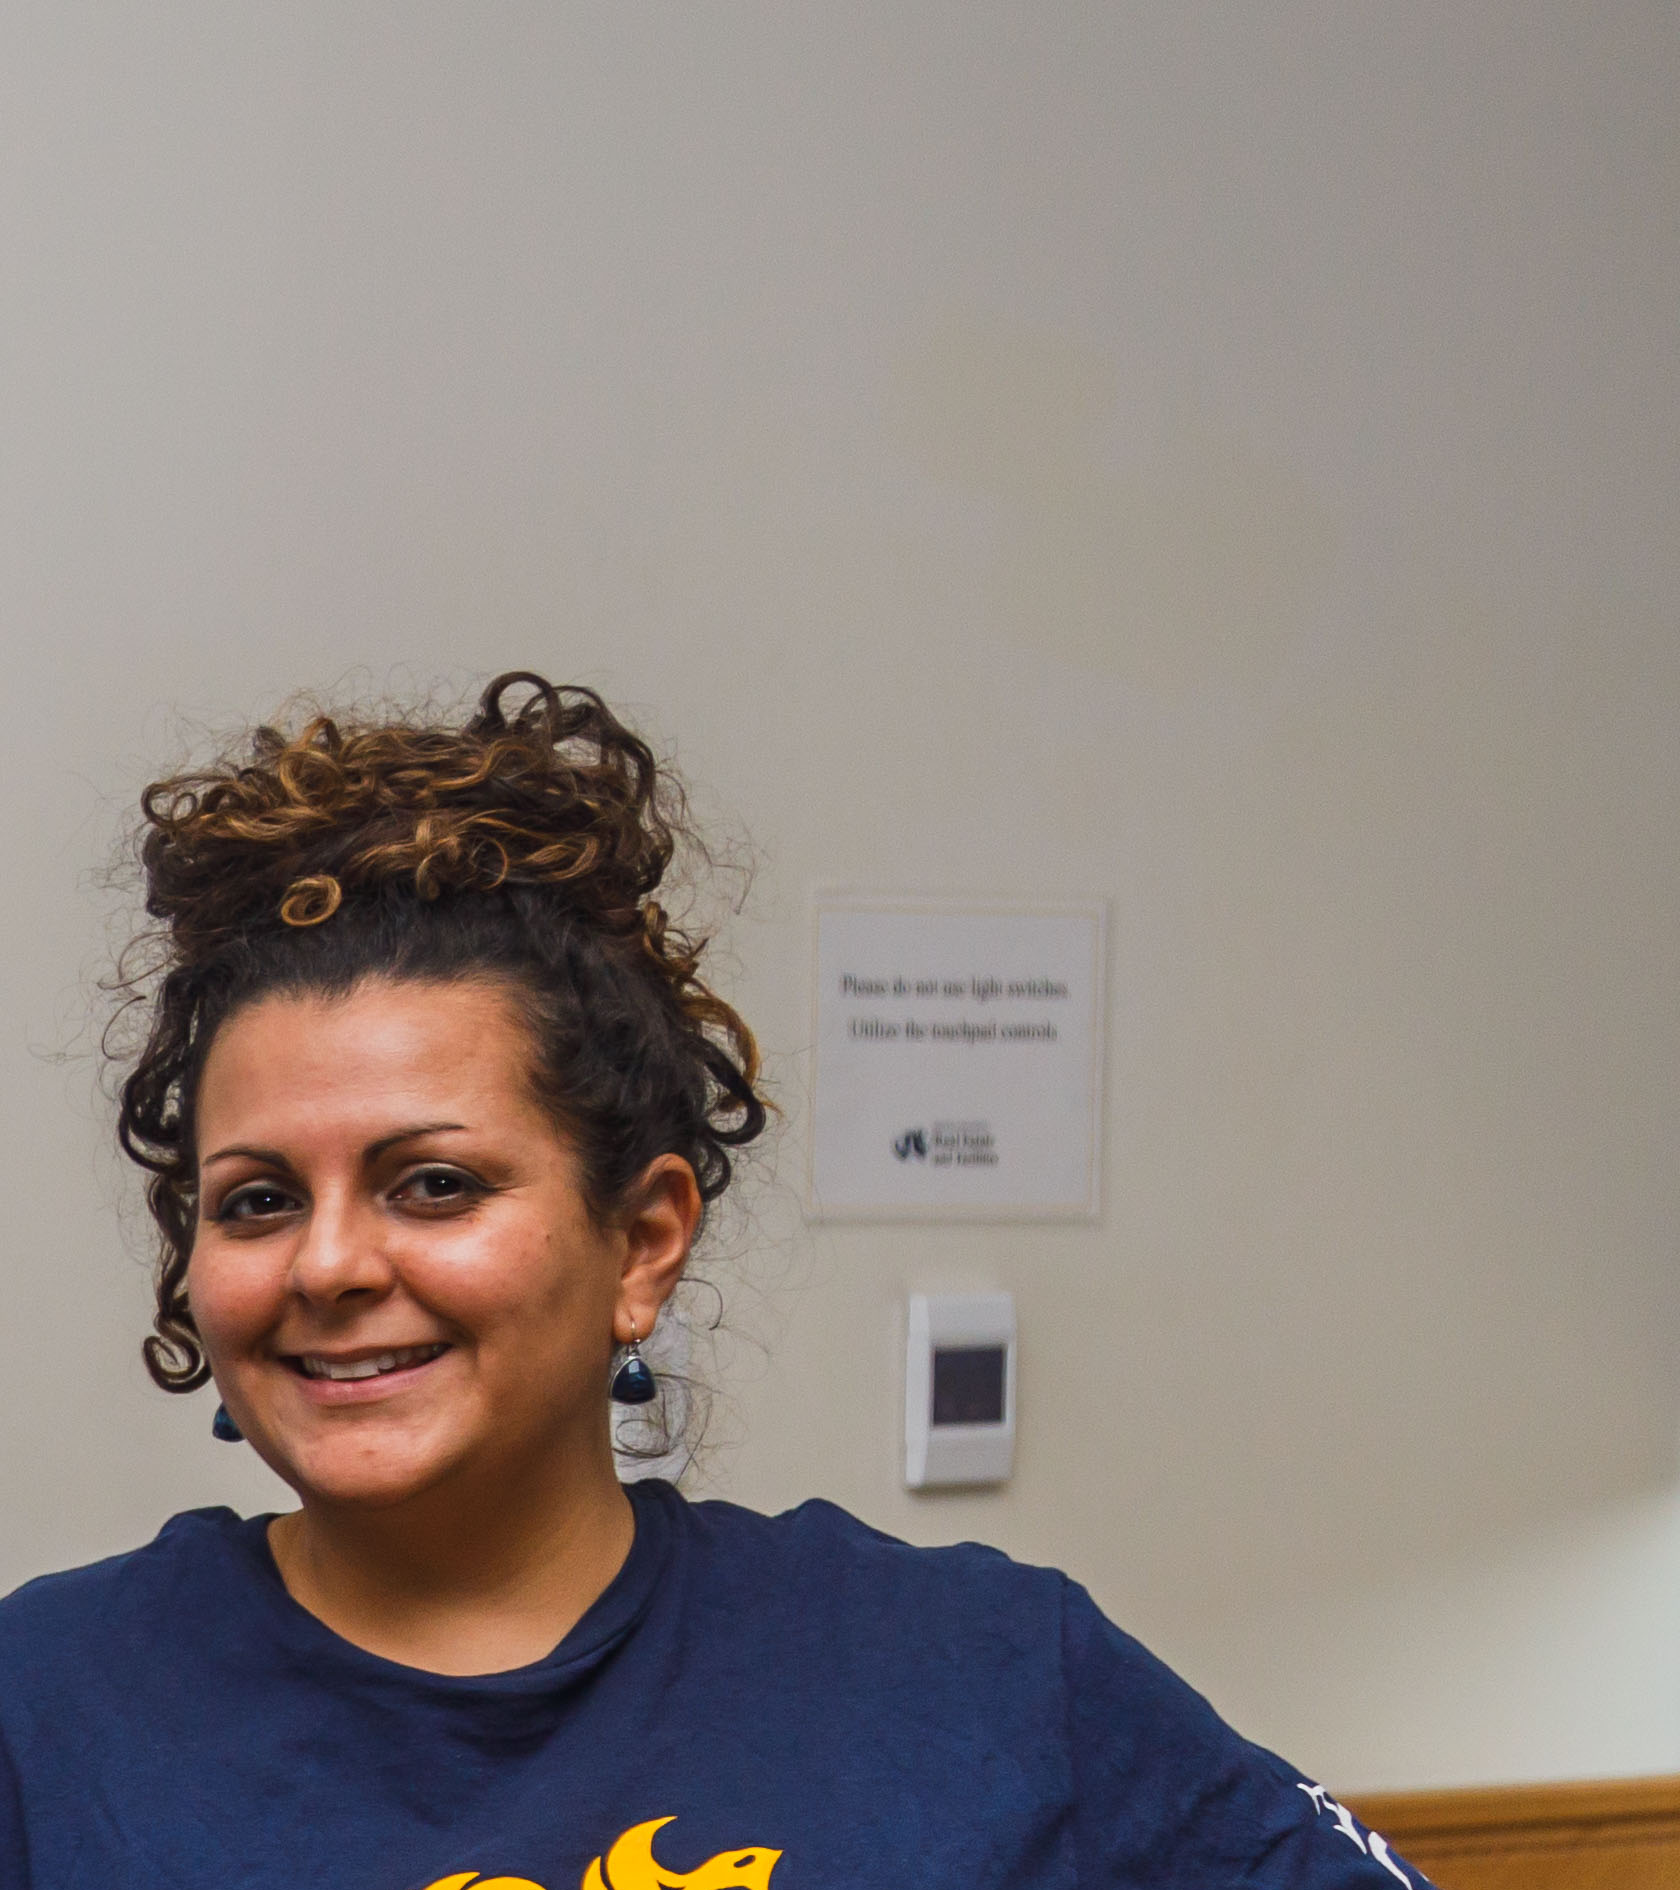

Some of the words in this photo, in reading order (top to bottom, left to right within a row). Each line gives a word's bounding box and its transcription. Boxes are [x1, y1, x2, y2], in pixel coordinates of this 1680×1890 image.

[841, 973, 886, 997] Please
[892, 974, 907, 997] do
[916, 978, 938, 997] not
[943, 980, 964, 997] use
[971, 974, 1003, 1003] light
[850, 1017, 899, 1041] Utilize
[904, 1017, 926, 1041] the
[931, 1019, 997, 1045] touchpad
